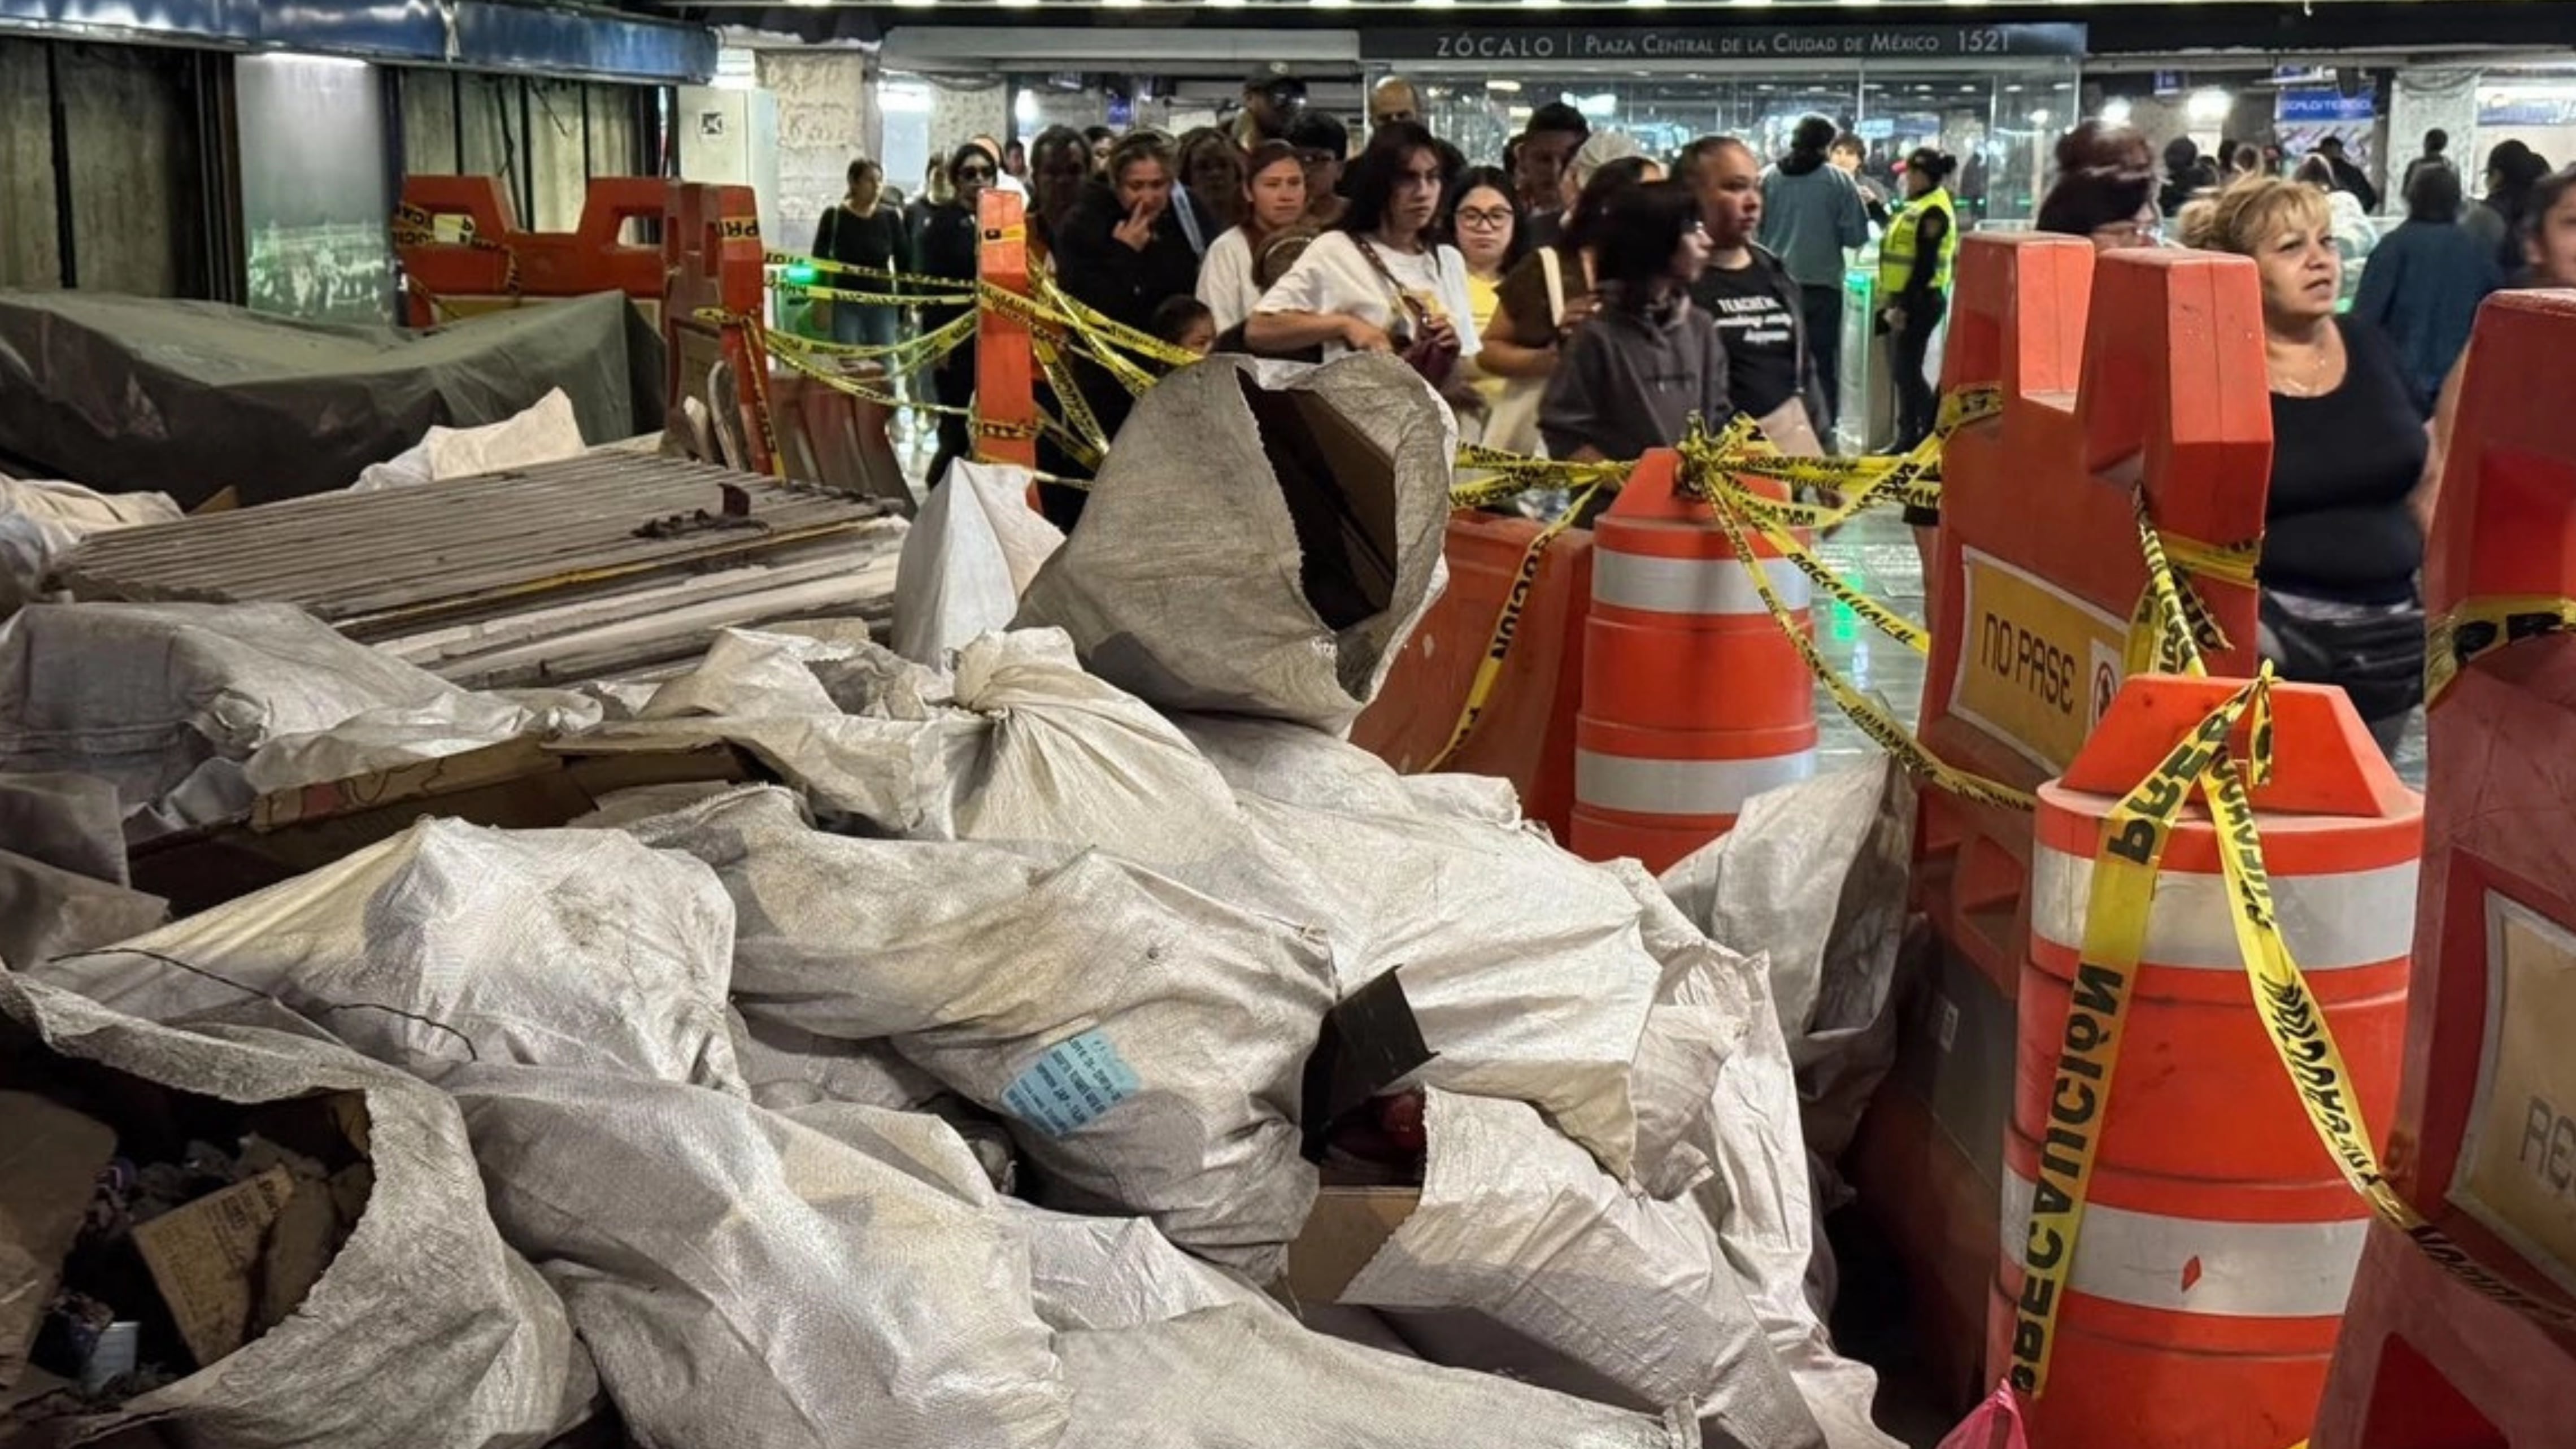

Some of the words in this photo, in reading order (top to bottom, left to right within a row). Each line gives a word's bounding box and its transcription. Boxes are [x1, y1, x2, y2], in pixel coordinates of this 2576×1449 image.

[1437, 32, 1554, 56] ZÓCALO
[1585, 34, 1635, 55] PLAZA
[1642, 34, 1714, 54] CENTRAL
[1773, 33, 1837, 53] CIUDAD
[1959, 30, 2009, 51] 1521
[1981, 612, 2012, 675] NO
[2015, 628, 2076, 716] PASE
[2518, 1095, 2576, 1193] RE
